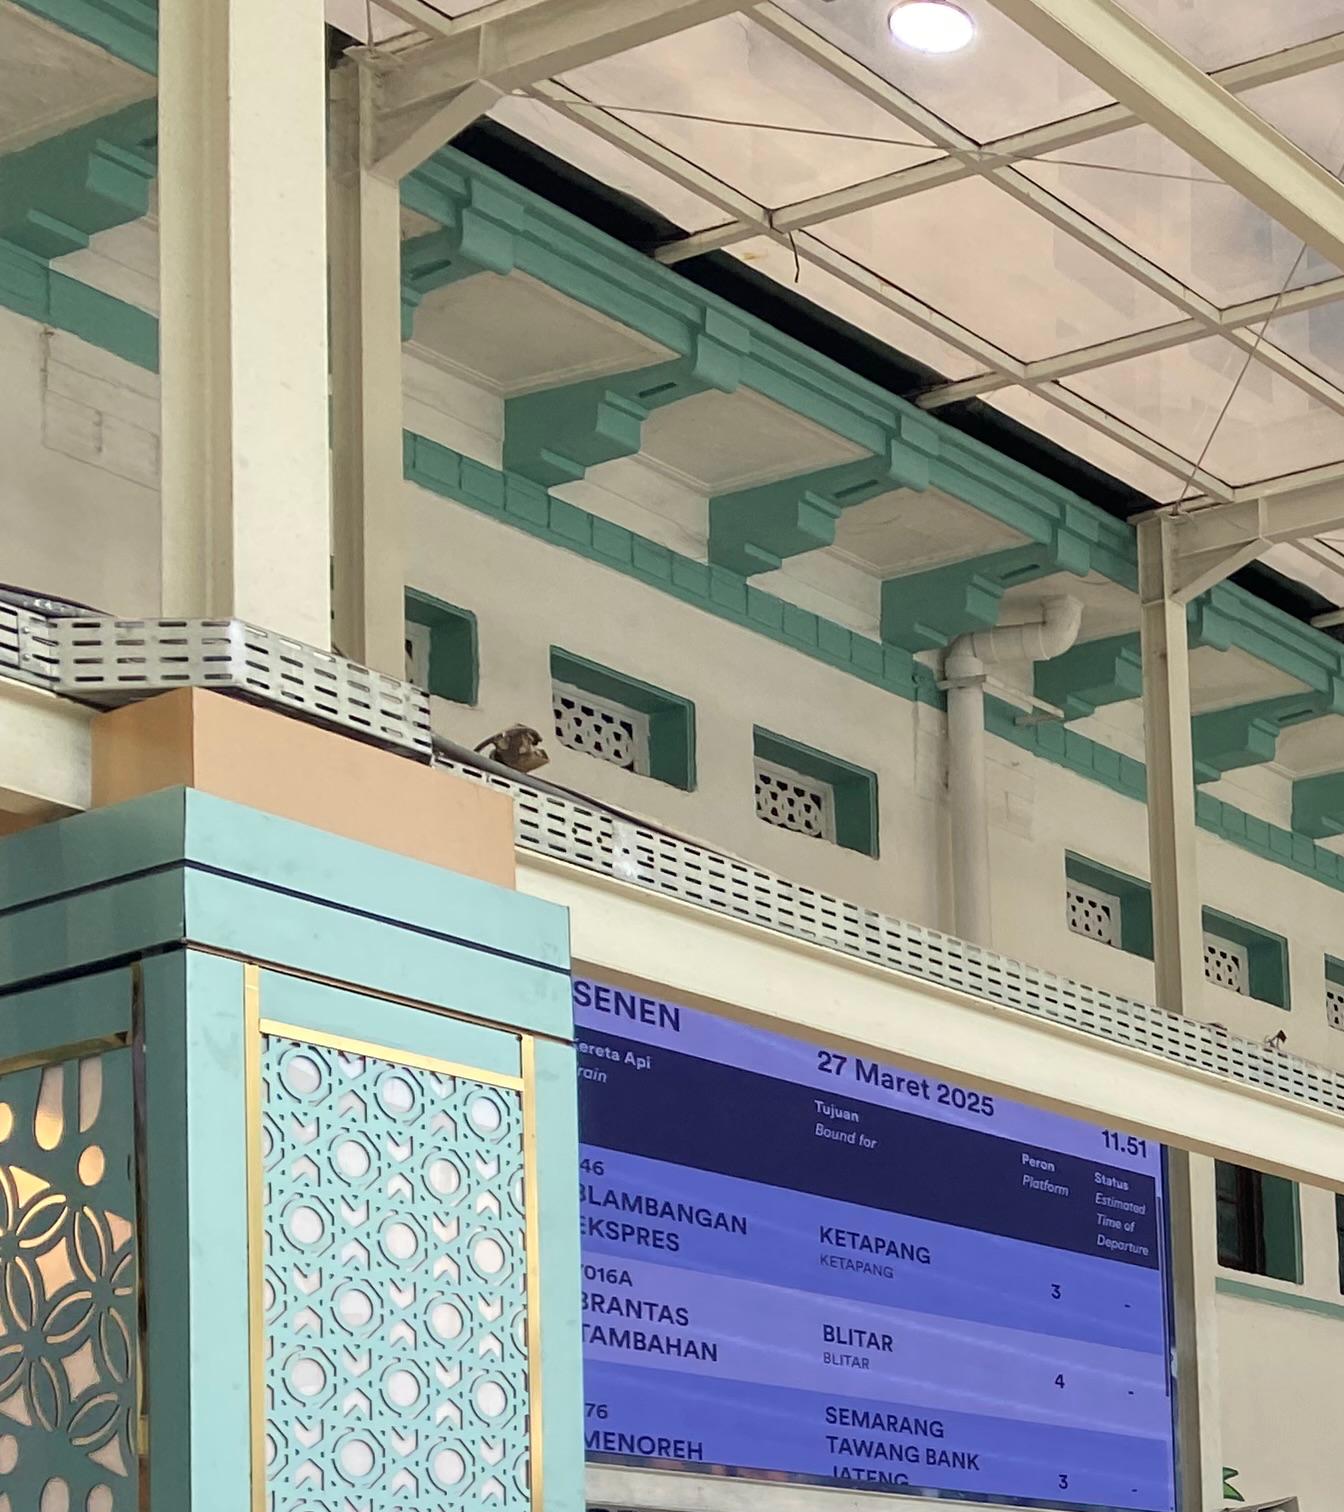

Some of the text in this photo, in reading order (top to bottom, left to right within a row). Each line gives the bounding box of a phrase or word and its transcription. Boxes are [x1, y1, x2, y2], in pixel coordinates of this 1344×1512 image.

[574, 980, 681, 1033] SENEN
[624, 1051, 652, 1071] Api
[817, 1051, 995, 1118] 27 Maret 2025
[814, 1099, 860, 1124] Tujuan
[814, 1123, 878, 1150] Bound for
[1100, 1128, 1148, 1159] 11.51
[1021, 1153, 1056, 1173] Peron
[1022, 1174, 1070, 1197] Platform
[1094, 1172, 1130, 1192] Status
[1095, 1192, 1147, 1216] Estimated
[1096, 1213, 1136, 1233] Time of
[819, 1225, 932, 1266] KETAPANG
[1096, 1234, 1150, 1257] Departure
[819, 1253, 895, 1281] KETAPANG
[1050, 1283, 1062, 1300] 3
[822, 1323, 894, 1353] BLITAR
[823, 1351, 870, 1371] BLITAR
[1054, 1373, 1066, 1389] 4
[825, 1405, 945, 1438] SEMARANG
[826, 1434, 981, 1472] TAWANG BANK
[1058, 1474, 1069, 1490] 3
